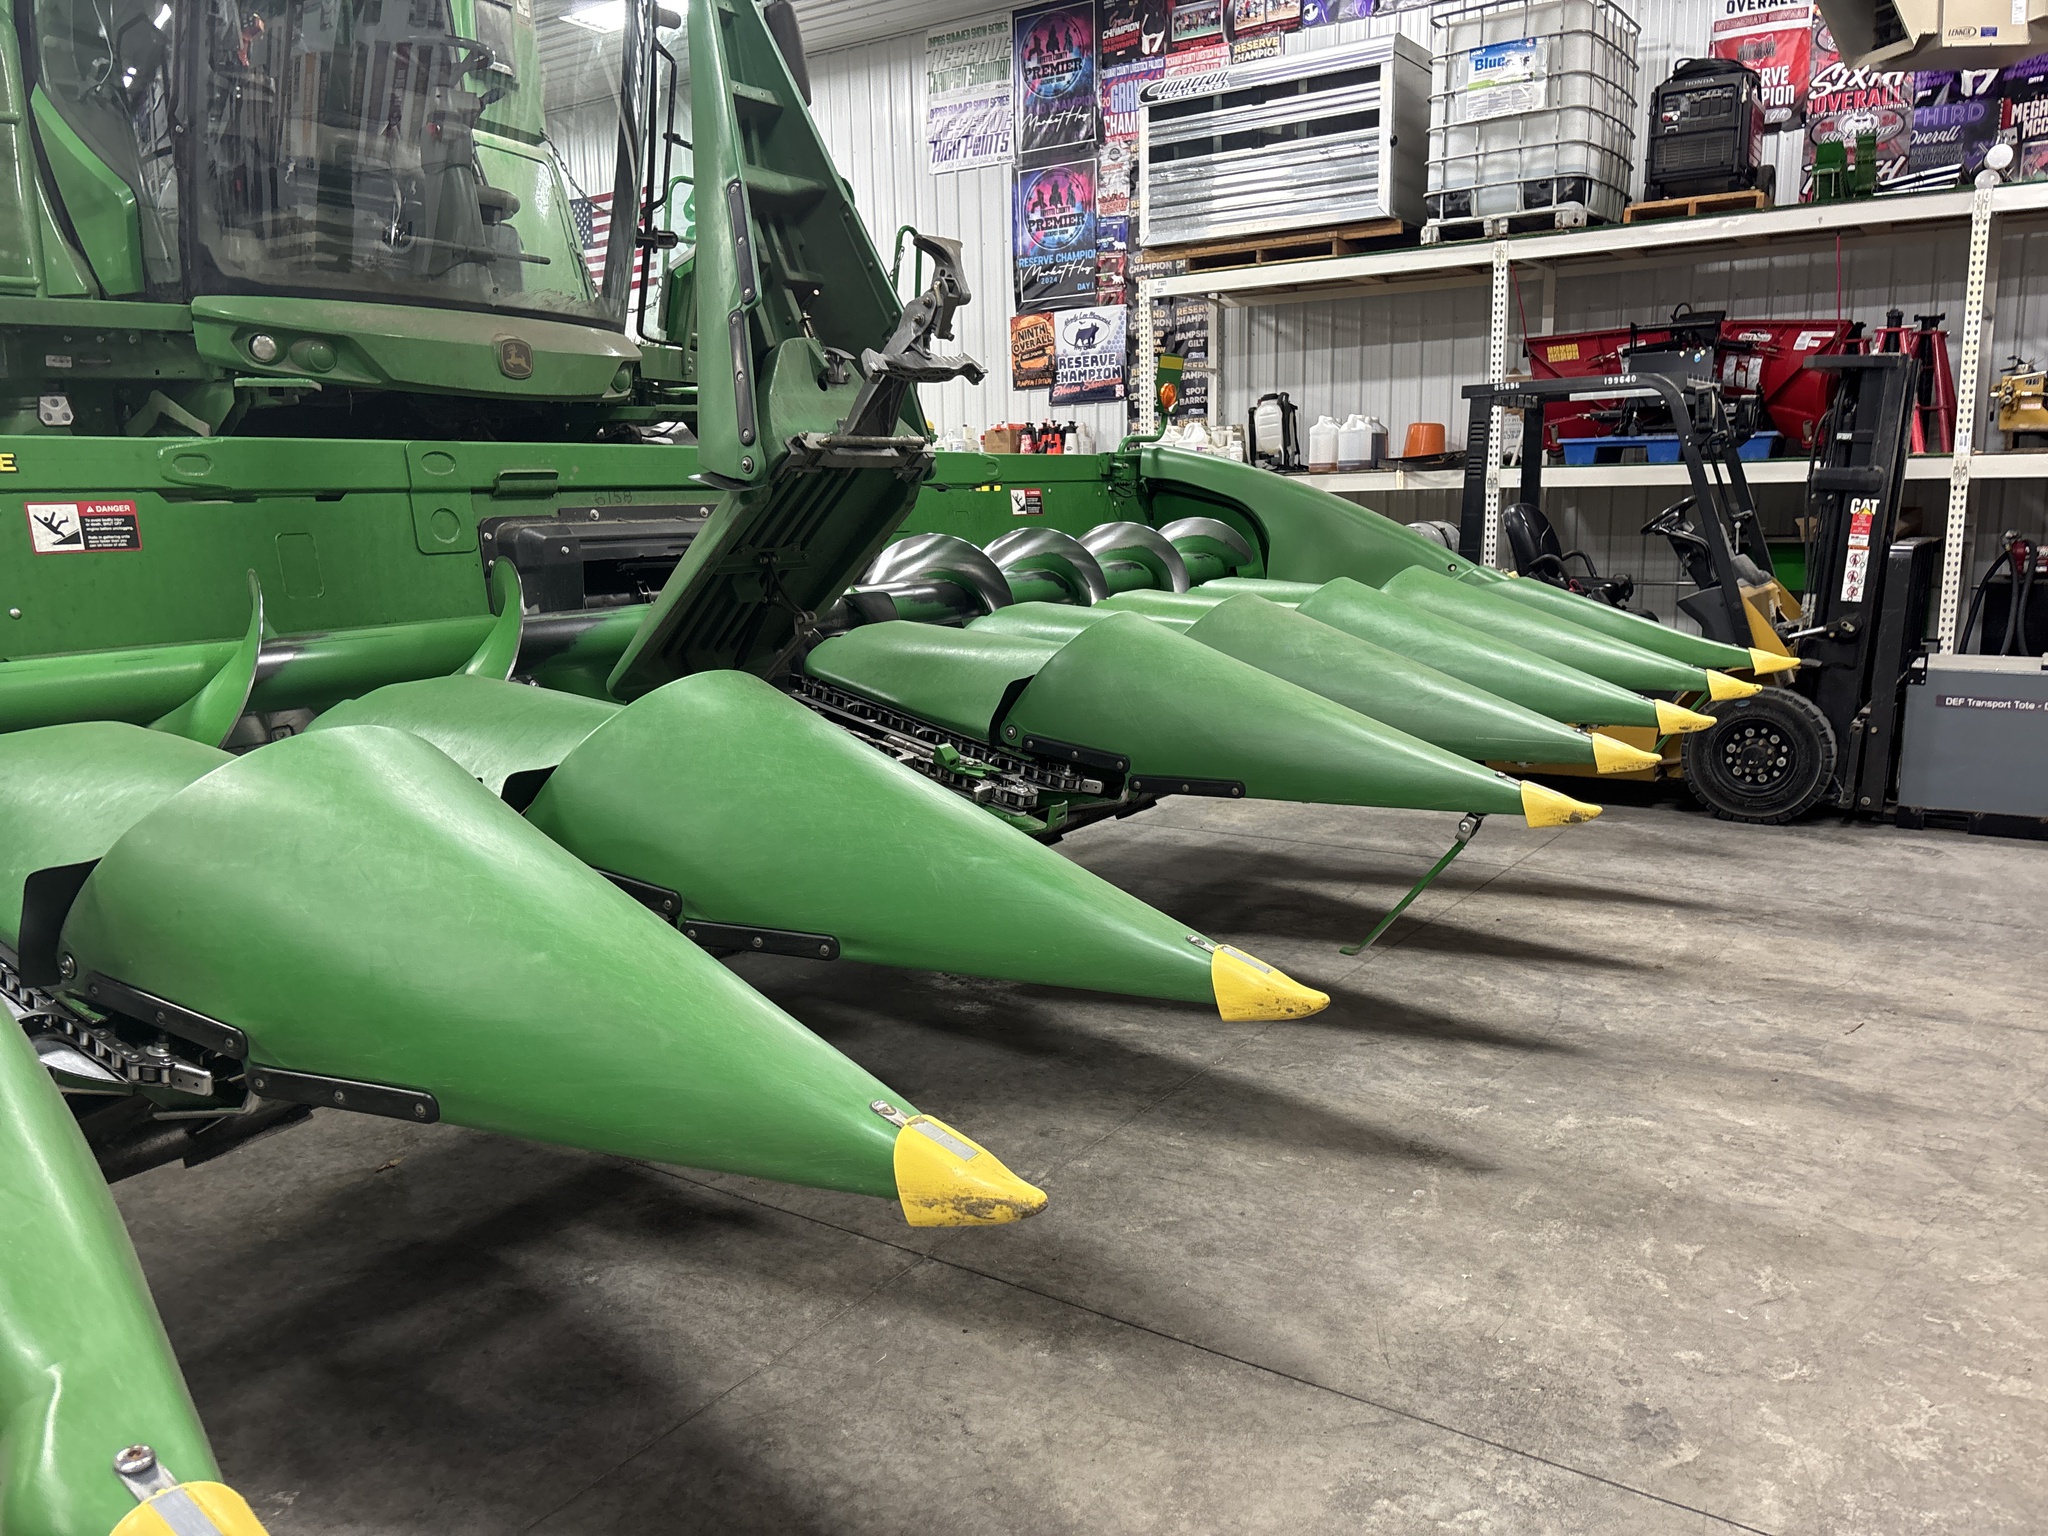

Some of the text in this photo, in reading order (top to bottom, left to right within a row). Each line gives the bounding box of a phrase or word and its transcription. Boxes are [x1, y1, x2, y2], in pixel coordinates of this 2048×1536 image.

[946, 28, 971, 45] SUMMER
[970, 25, 988, 39] SHOW
[988, 21, 1009, 35] SERIES
[1102, 21, 1140, 39] CHAMPION
[1948, 26, 1977, 37] LENNOX
[1233, 36, 1279, 54] RESERVE
[1232, 47, 1281, 64] CHAMPION
[1024, 57, 1083, 82] PREMIER
[1139, 70, 1230, 103] Cimarron
[1685, 77, 1715, 87] HONDA
[1156, 82, 1225, 100] TRAILERS
[1812, 86, 1902, 114] OVERALL
[1913, 102, 1985, 127] THIRD
[1909, 124, 1962, 146] Overall
[929, 131, 1011, 164] HIGH POINTS
[1027, 212, 1086, 235] PREMIER
[1019, 248, 1096, 268] RESERVE CHAMPION
[1129, 261, 1173, 274] CHAMPION
[1041, 276, 1058, 285] 2024
[1077, 281, 1091, 291] DAY
[1176, 304, 1209, 317] RESERV
[1017, 324, 1047, 341] NINTH
[1012, 335, 1054, 353] OVERALL
[1188, 338, 1205, 348] GILT
[1058, 353, 1117, 370] RESERVE
[1055, 366, 1123, 384] CHAMPION
[1604, 374, 1637, 385] 199640
[1186, 387, 1206, 396] SPOT
[1494, 382, 1520, 391] 85696
[95, 504, 131, 513] DANGER
[1850, 498, 1880, 516] CAT
[1945, 696, 1965, 706] DEF
[1967, 698, 2012, 710] Transport
[2014, 700, 2036, 710] Tote
